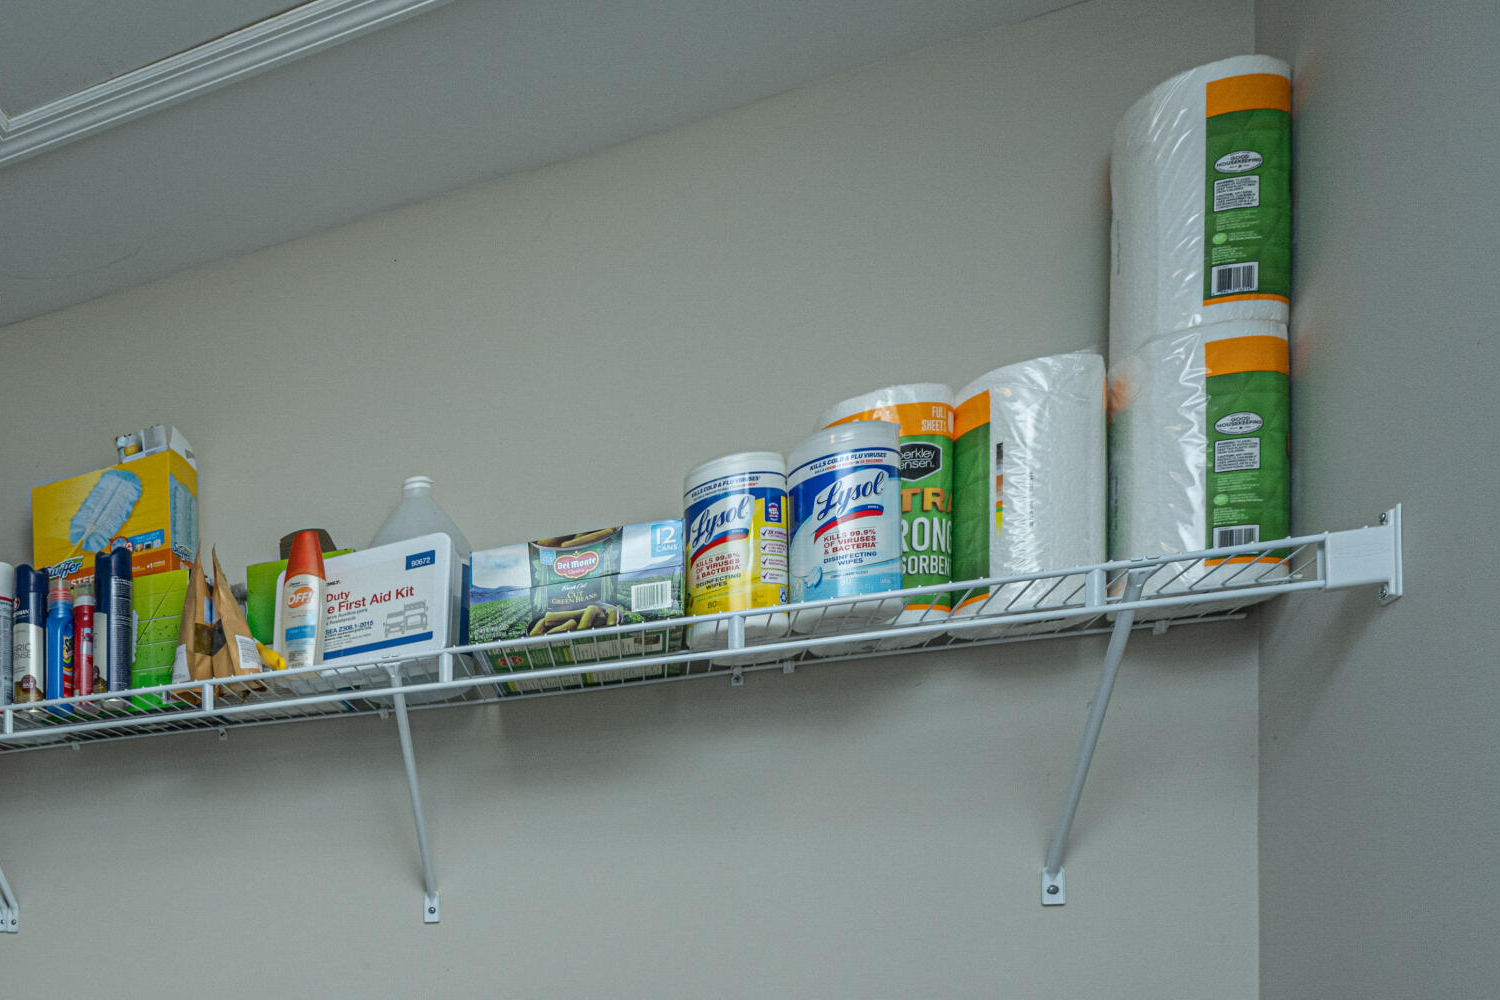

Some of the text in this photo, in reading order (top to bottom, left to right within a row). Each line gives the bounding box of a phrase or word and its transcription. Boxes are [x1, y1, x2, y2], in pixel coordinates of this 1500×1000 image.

[932, 406, 946, 419] FULL
[810, 460, 826, 472] KILLS
[827, 458, 844, 466] COLD
[850, 454, 863, 462] FLU
[816, 471, 884, 521] Lysol
[691, 495, 750, 548] Lysol
[655, 526, 677, 545] 12
[824, 528, 876, 543] KILLS 99.9%
[655, 544, 678, 553] CANS
[824, 536, 876, 549] OF VIRUSES
[832, 542, 876, 553] BACTERIA
[410, 556, 431, 568] 90672
[556, 557, 596, 570] Del Monte
[824, 551, 877, 564] DISINFECTING
[838, 558, 864, 566] WIPES
[287, 588, 314, 604] OFF!
[326, 590, 350, 603] Duty
[338, 586, 414, 613] First Aid Kit
